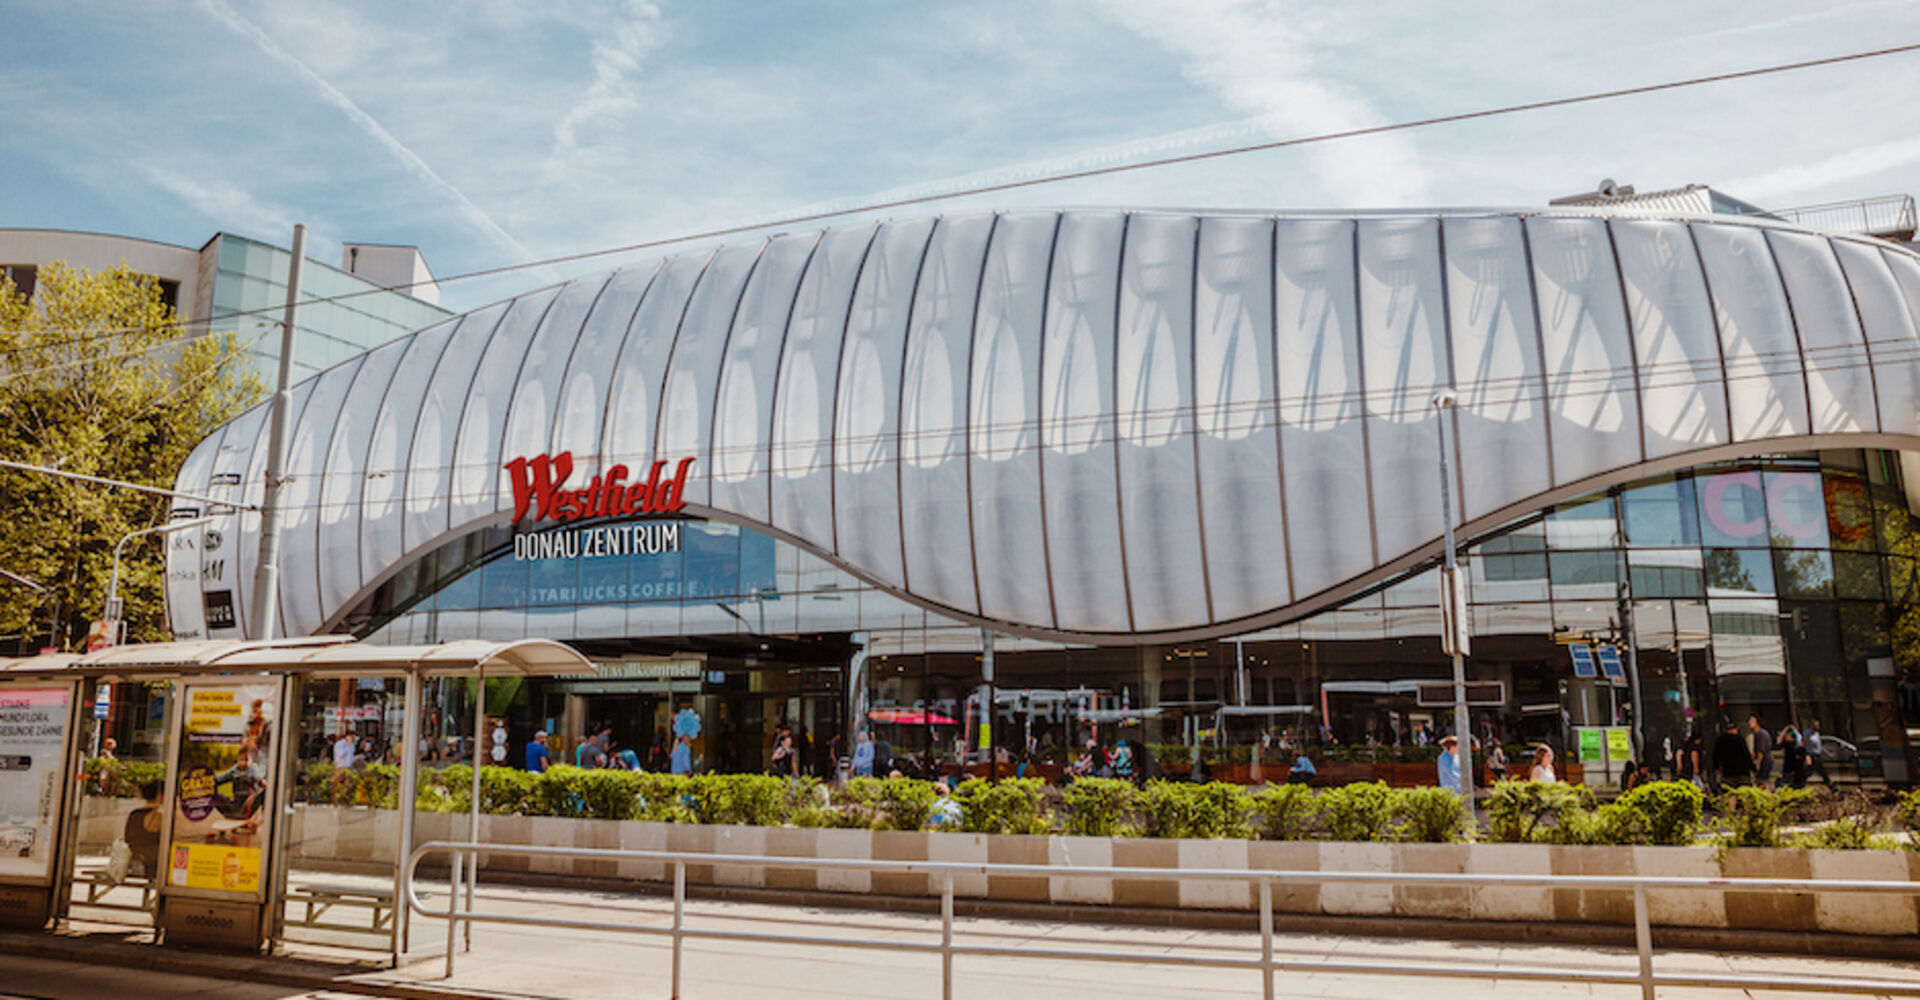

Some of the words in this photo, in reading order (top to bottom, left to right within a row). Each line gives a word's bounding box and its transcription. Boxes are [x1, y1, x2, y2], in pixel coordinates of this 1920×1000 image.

[503, 451, 696, 523] Westfield
[515, 527, 579, 561] DONAU
[583, 523, 680, 557] ZENTRUM
